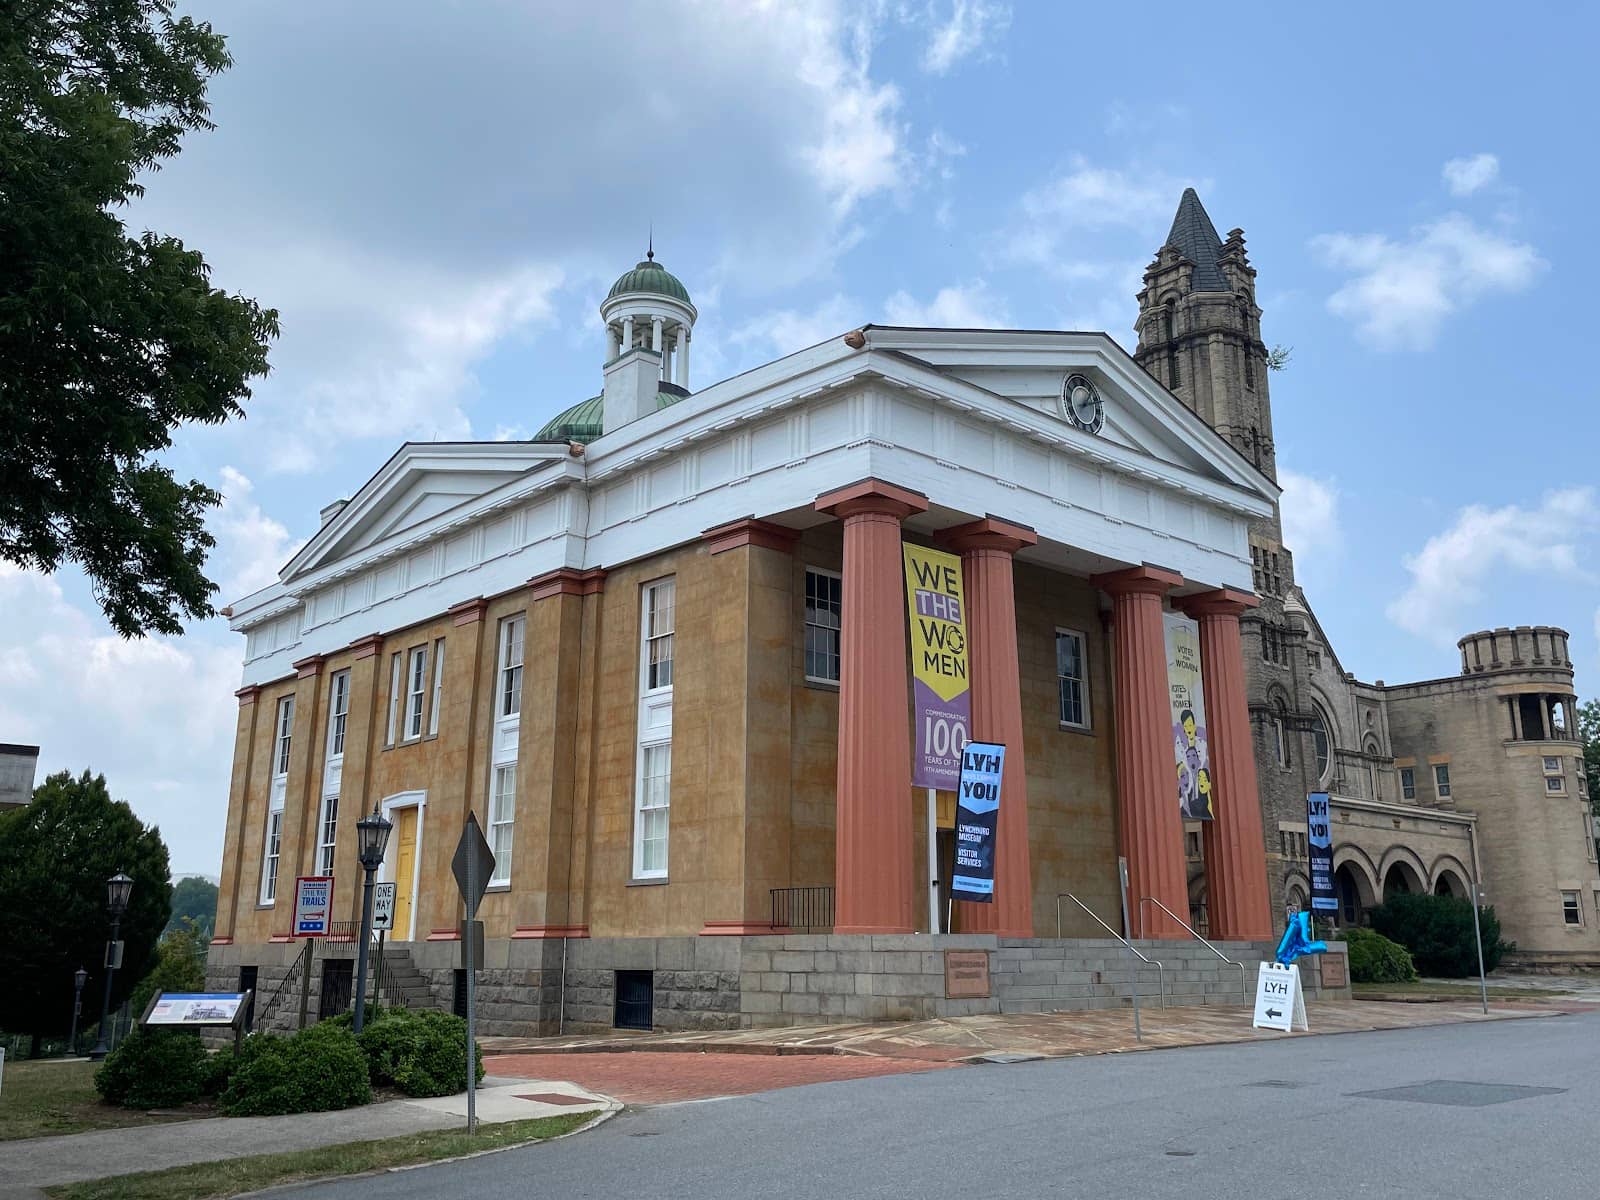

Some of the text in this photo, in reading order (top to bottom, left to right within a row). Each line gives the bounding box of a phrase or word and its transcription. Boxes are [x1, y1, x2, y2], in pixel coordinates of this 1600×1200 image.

[911, 558, 959, 597] WE
[916, 590, 961, 623] THE
[919, 619, 964, 654] WO
[1177, 645, 1194, 657] VOTES
[924, 651, 966, 679] MEN
[1176, 659, 1198, 673] WOMEN
[925, 709, 967, 721] COMMEMORATING
[925, 716, 967, 760] 100
[925, 756, 961, 768] YEARS OF TH
[963, 752, 1001, 774] LYH
[962, 780, 998, 802] YOU
[1309, 801, 1327, 816] LYH
[959, 823, 990, 836] LYNCHBURG
[958, 831, 982, 843] MUSEUM
[958, 848, 978, 859] VISITOR
[957, 857, 982, 868] SERVICES
[377, 886, 392, 898] ONE
[302, 897, 326, 906] TRAILS
[375, 899, 391, 911] WAY
[1264, 982, 1288, 995] LYH
